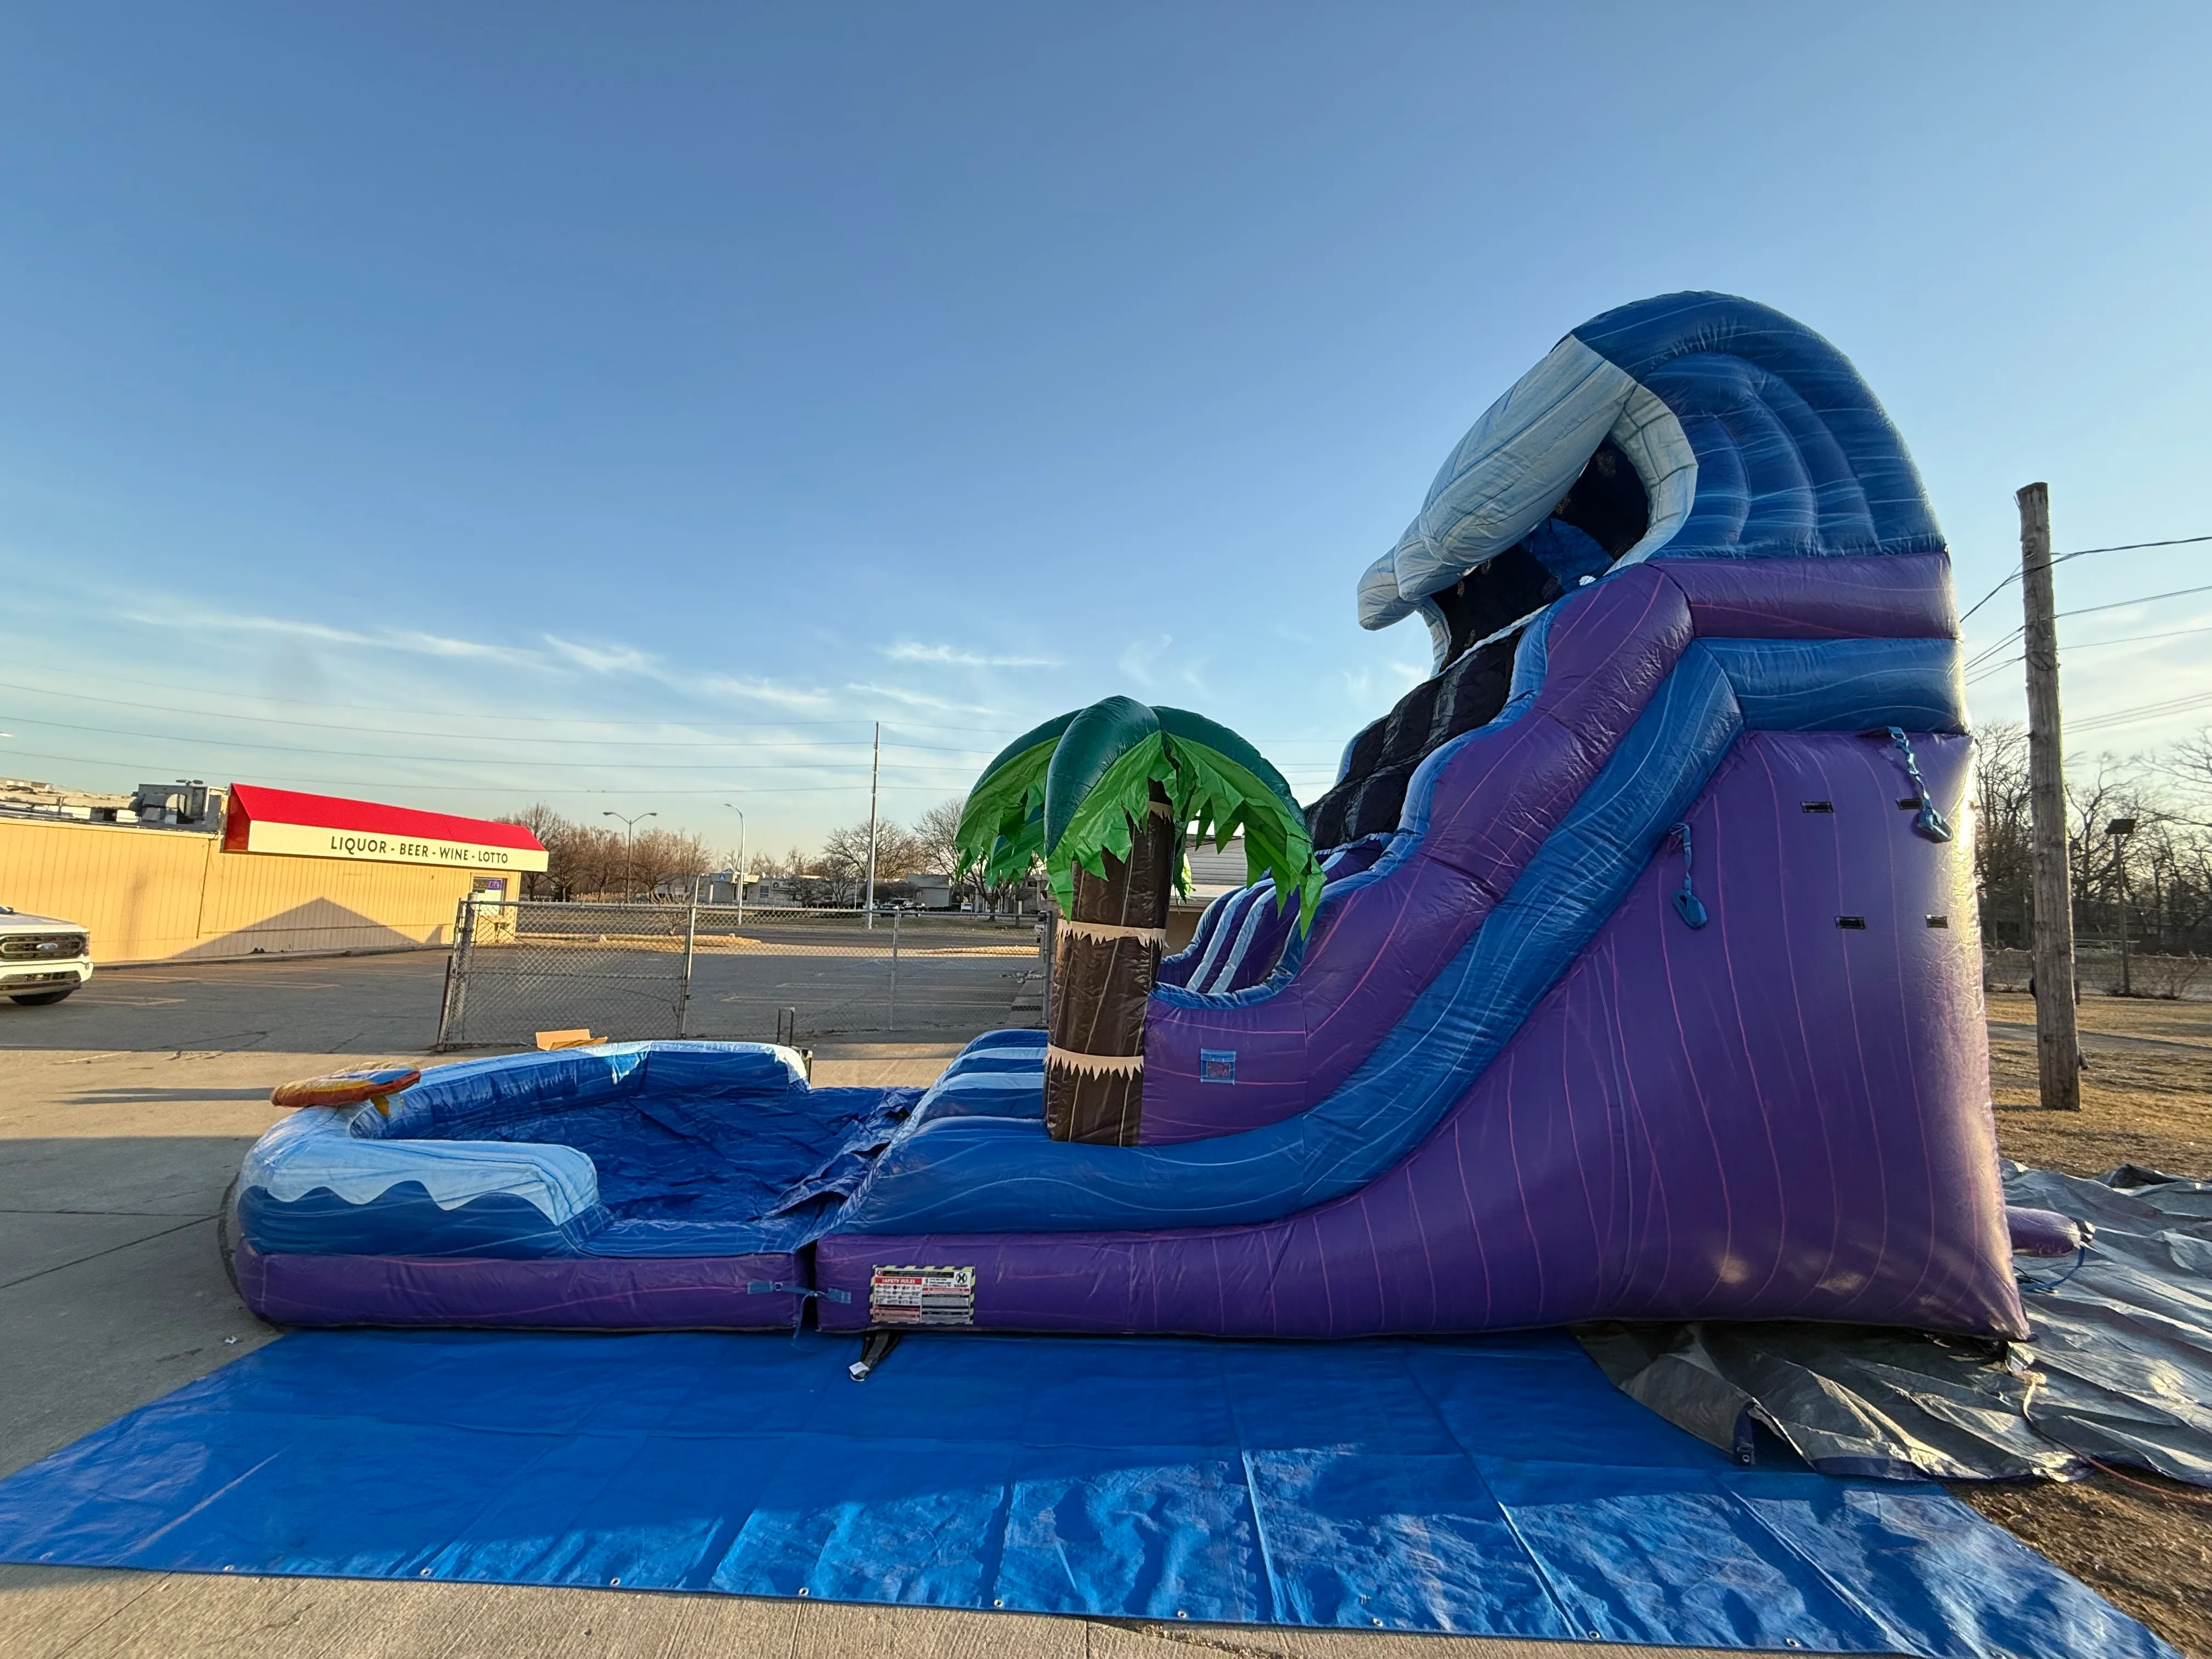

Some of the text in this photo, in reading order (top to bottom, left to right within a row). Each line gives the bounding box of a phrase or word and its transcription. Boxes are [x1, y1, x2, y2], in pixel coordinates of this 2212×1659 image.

[331, 836, 386, 855] LIQUOR
[399, 843, 428, 857] BEER
[439, 847, 469, 860] WINE
[478, 851, 508, 864] LOTTO
